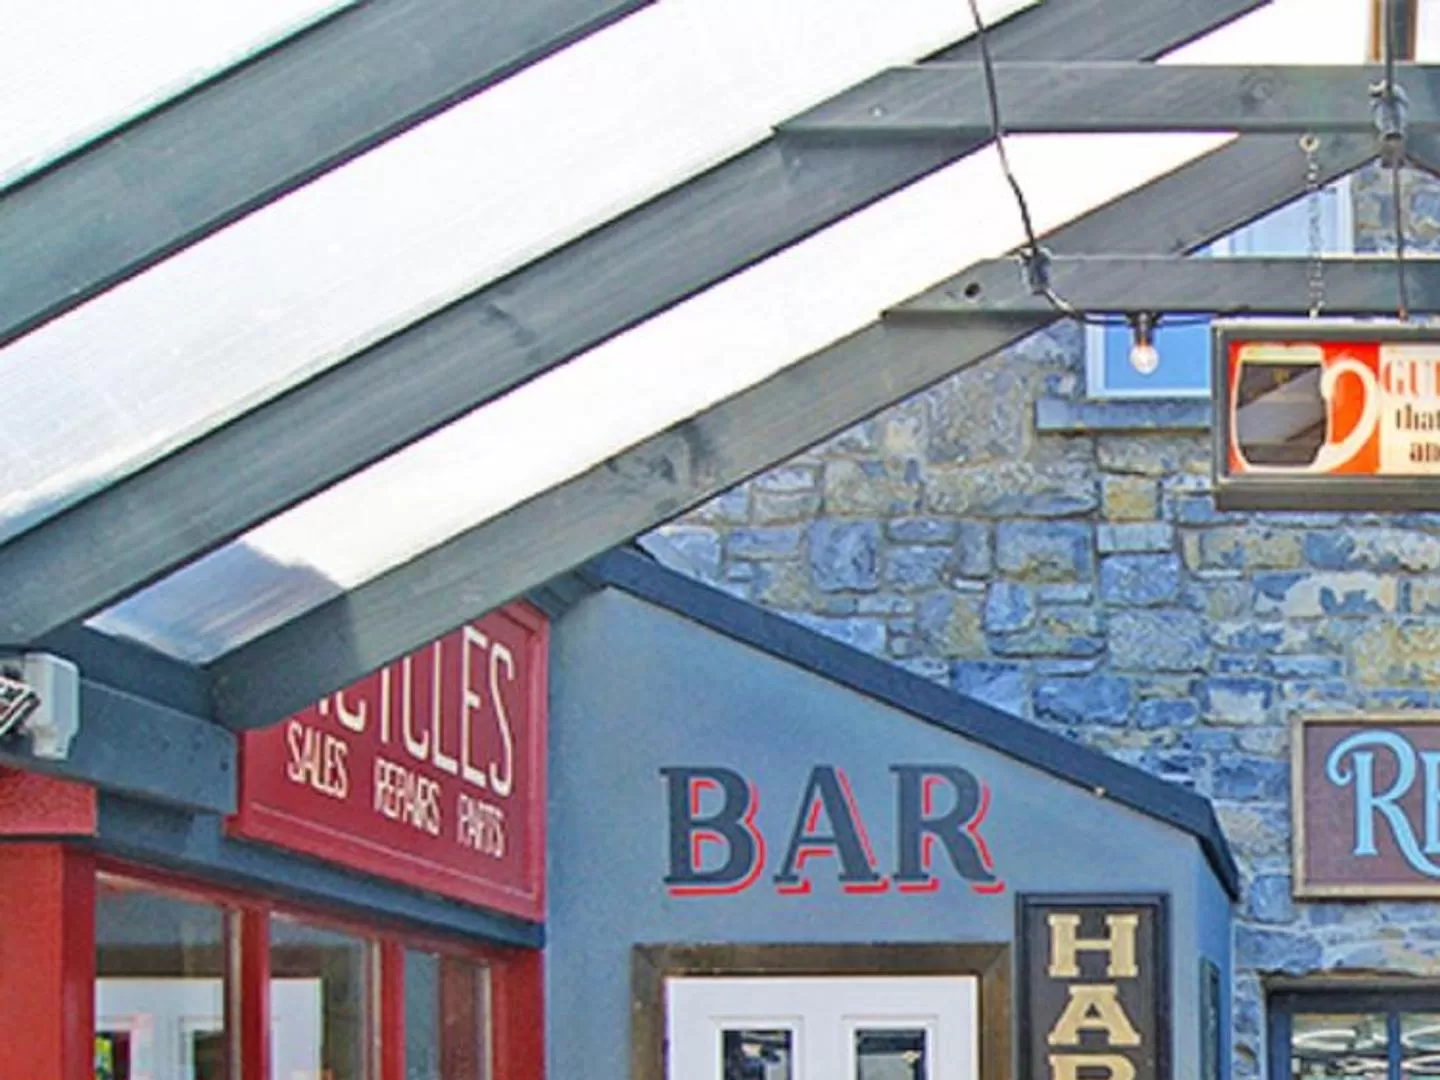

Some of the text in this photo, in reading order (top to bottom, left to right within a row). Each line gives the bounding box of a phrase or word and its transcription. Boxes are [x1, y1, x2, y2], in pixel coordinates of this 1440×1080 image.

[286, 720, 347, 799] SALES
[456, 793, 504, 858] PARTS
[659, 763, 1005, 895] BAR
